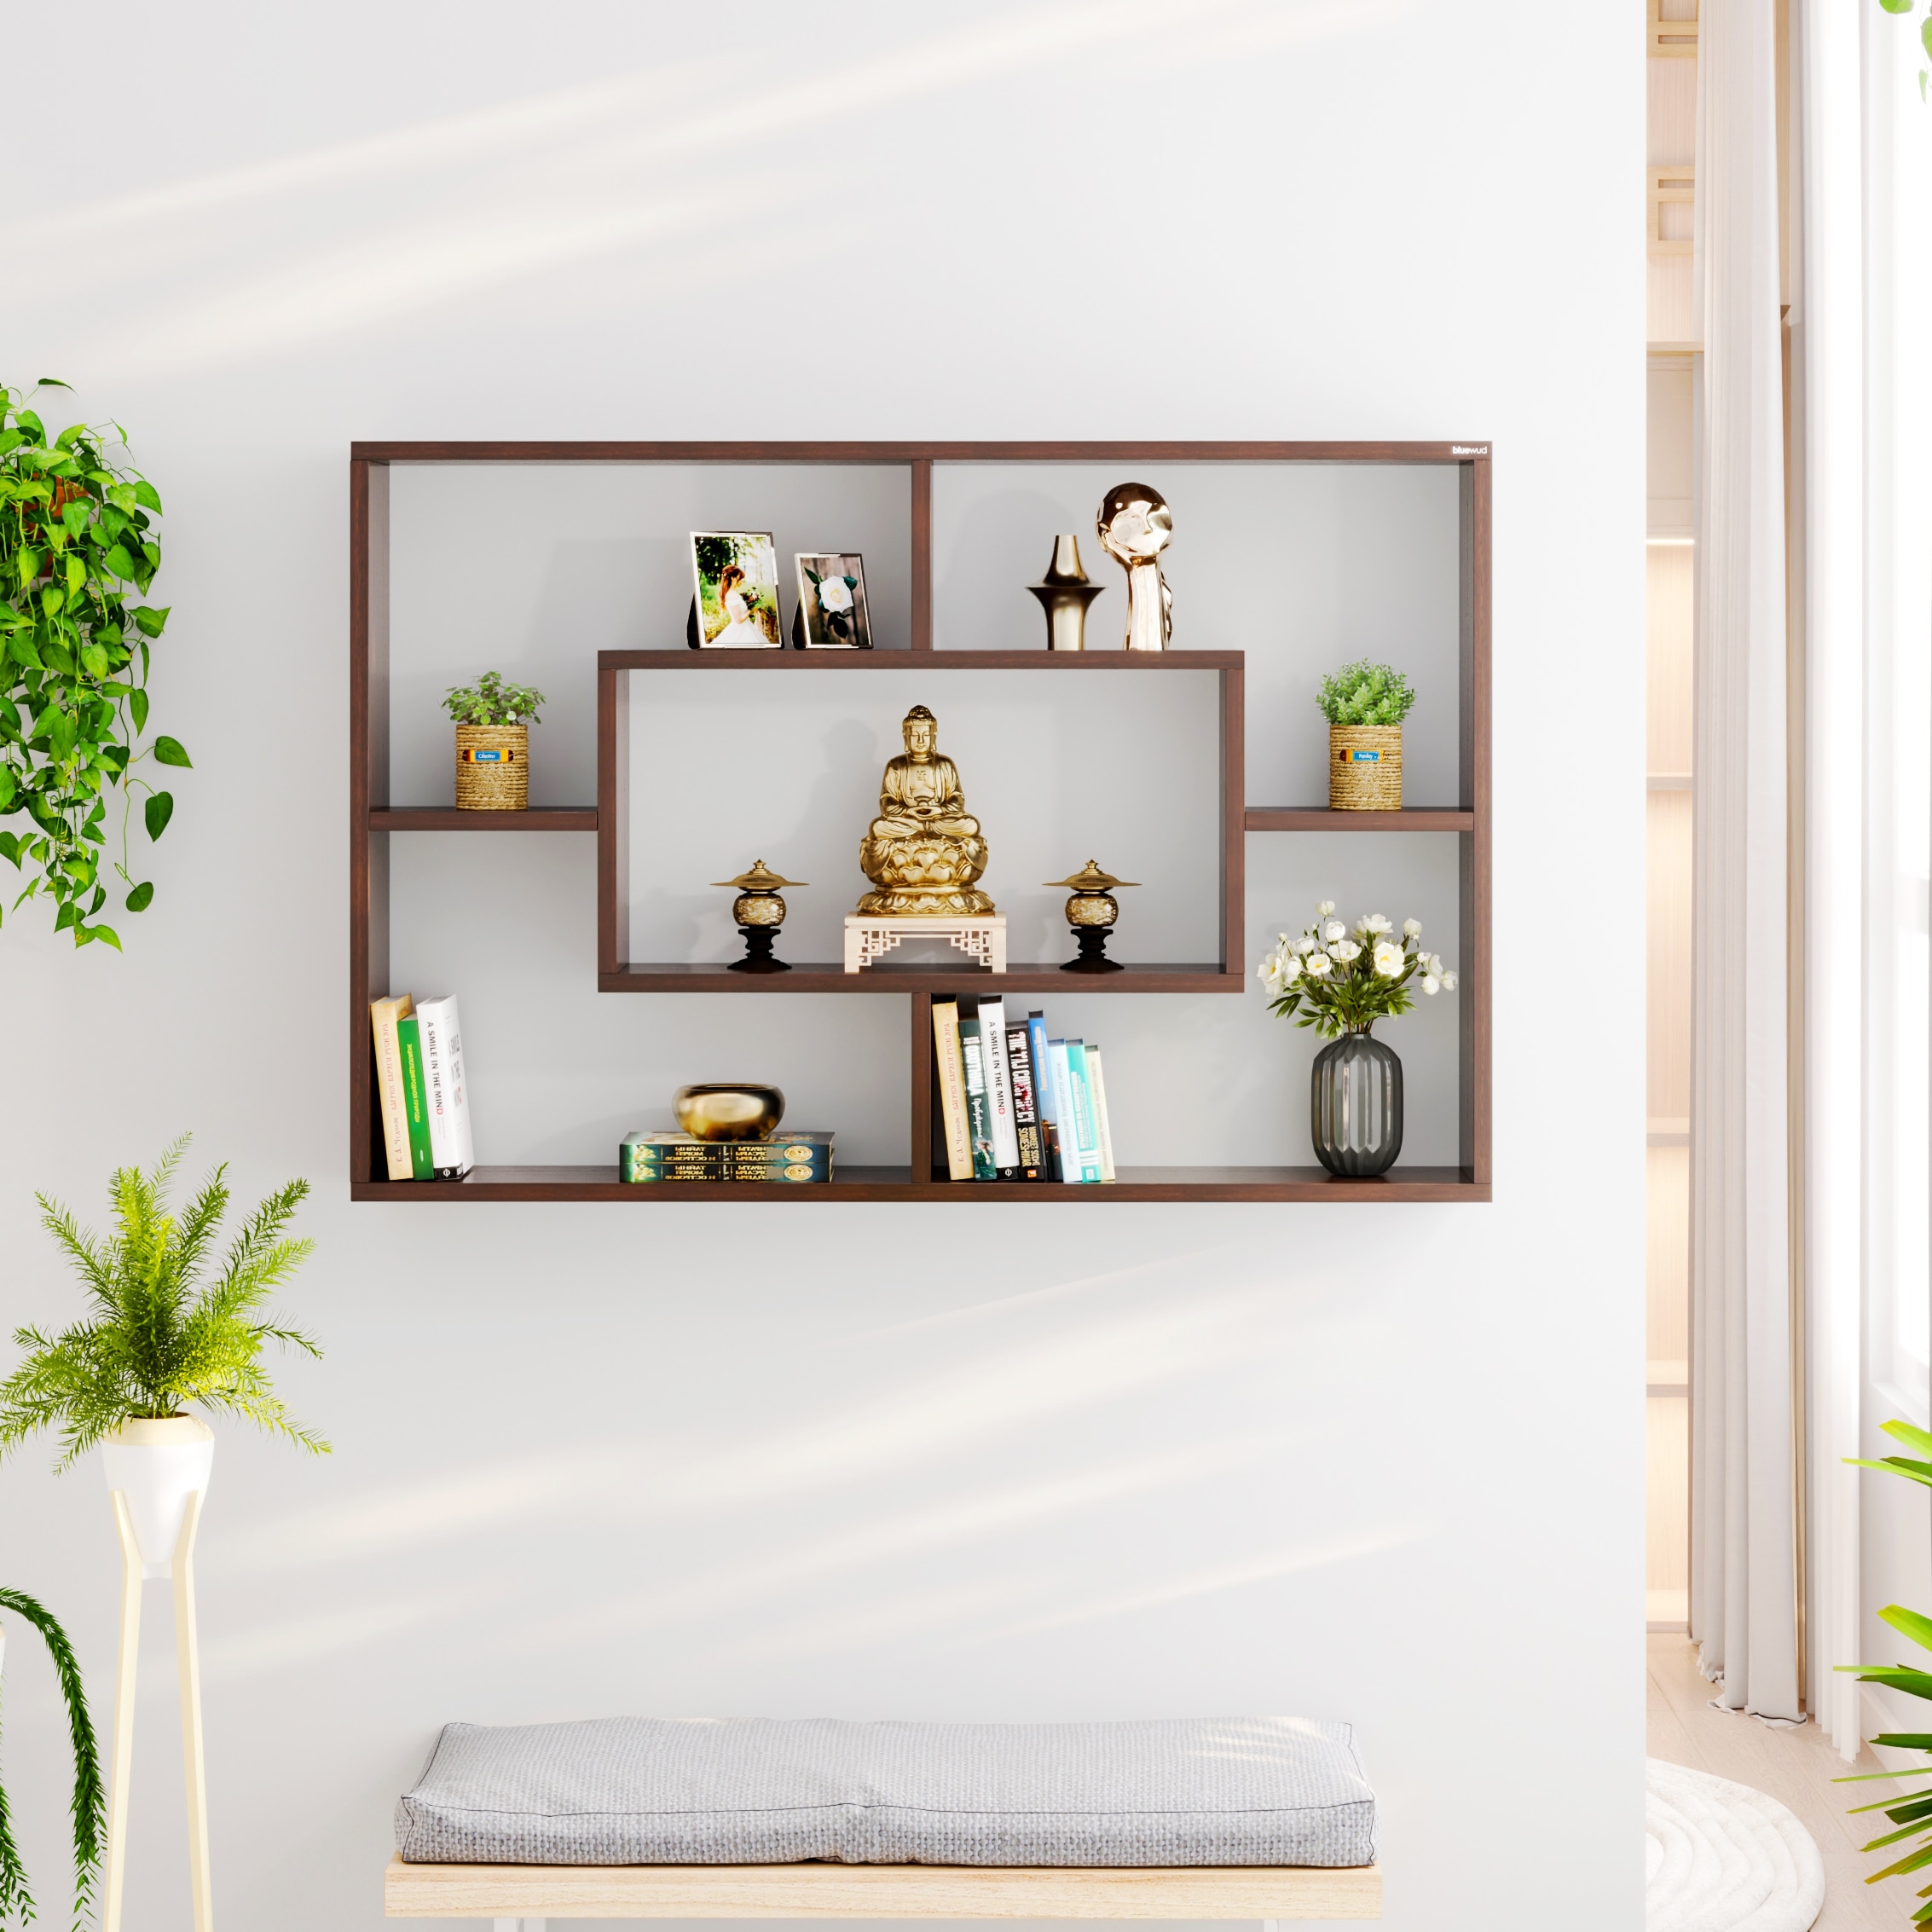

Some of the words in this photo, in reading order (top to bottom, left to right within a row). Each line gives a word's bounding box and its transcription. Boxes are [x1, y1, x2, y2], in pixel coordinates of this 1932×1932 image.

[1452, 445, 1488, 454] bluewud
[428, 1030, 437, 1057] SMILE
[989, 1030, 998, 1057] SMILE
[1008, 1031, 1027, 1051] THE
[407, 1043, 416, 1079] ЭНЦИКЛОПЕДИЯ
[431, 1060, 438, 1069] IN
[964, 1044, 983, 1096] ОХОТНИЦА
[992, 1060, 1000, 1069] IN
[1009, 1050, 1028, 1070] TAJ
[434, 1090, 443, 1115] MIND
[996, 1090, 1004, 1114] MIND
[1012, 1069, 1035, 1123] CONSPIRACY
[971, 1097, 983, 1138] Пробуждение
[1018, 1127, 1030, 1167] SOMESHWAR
[1030, 1149, 1040, 1166] SODHI
